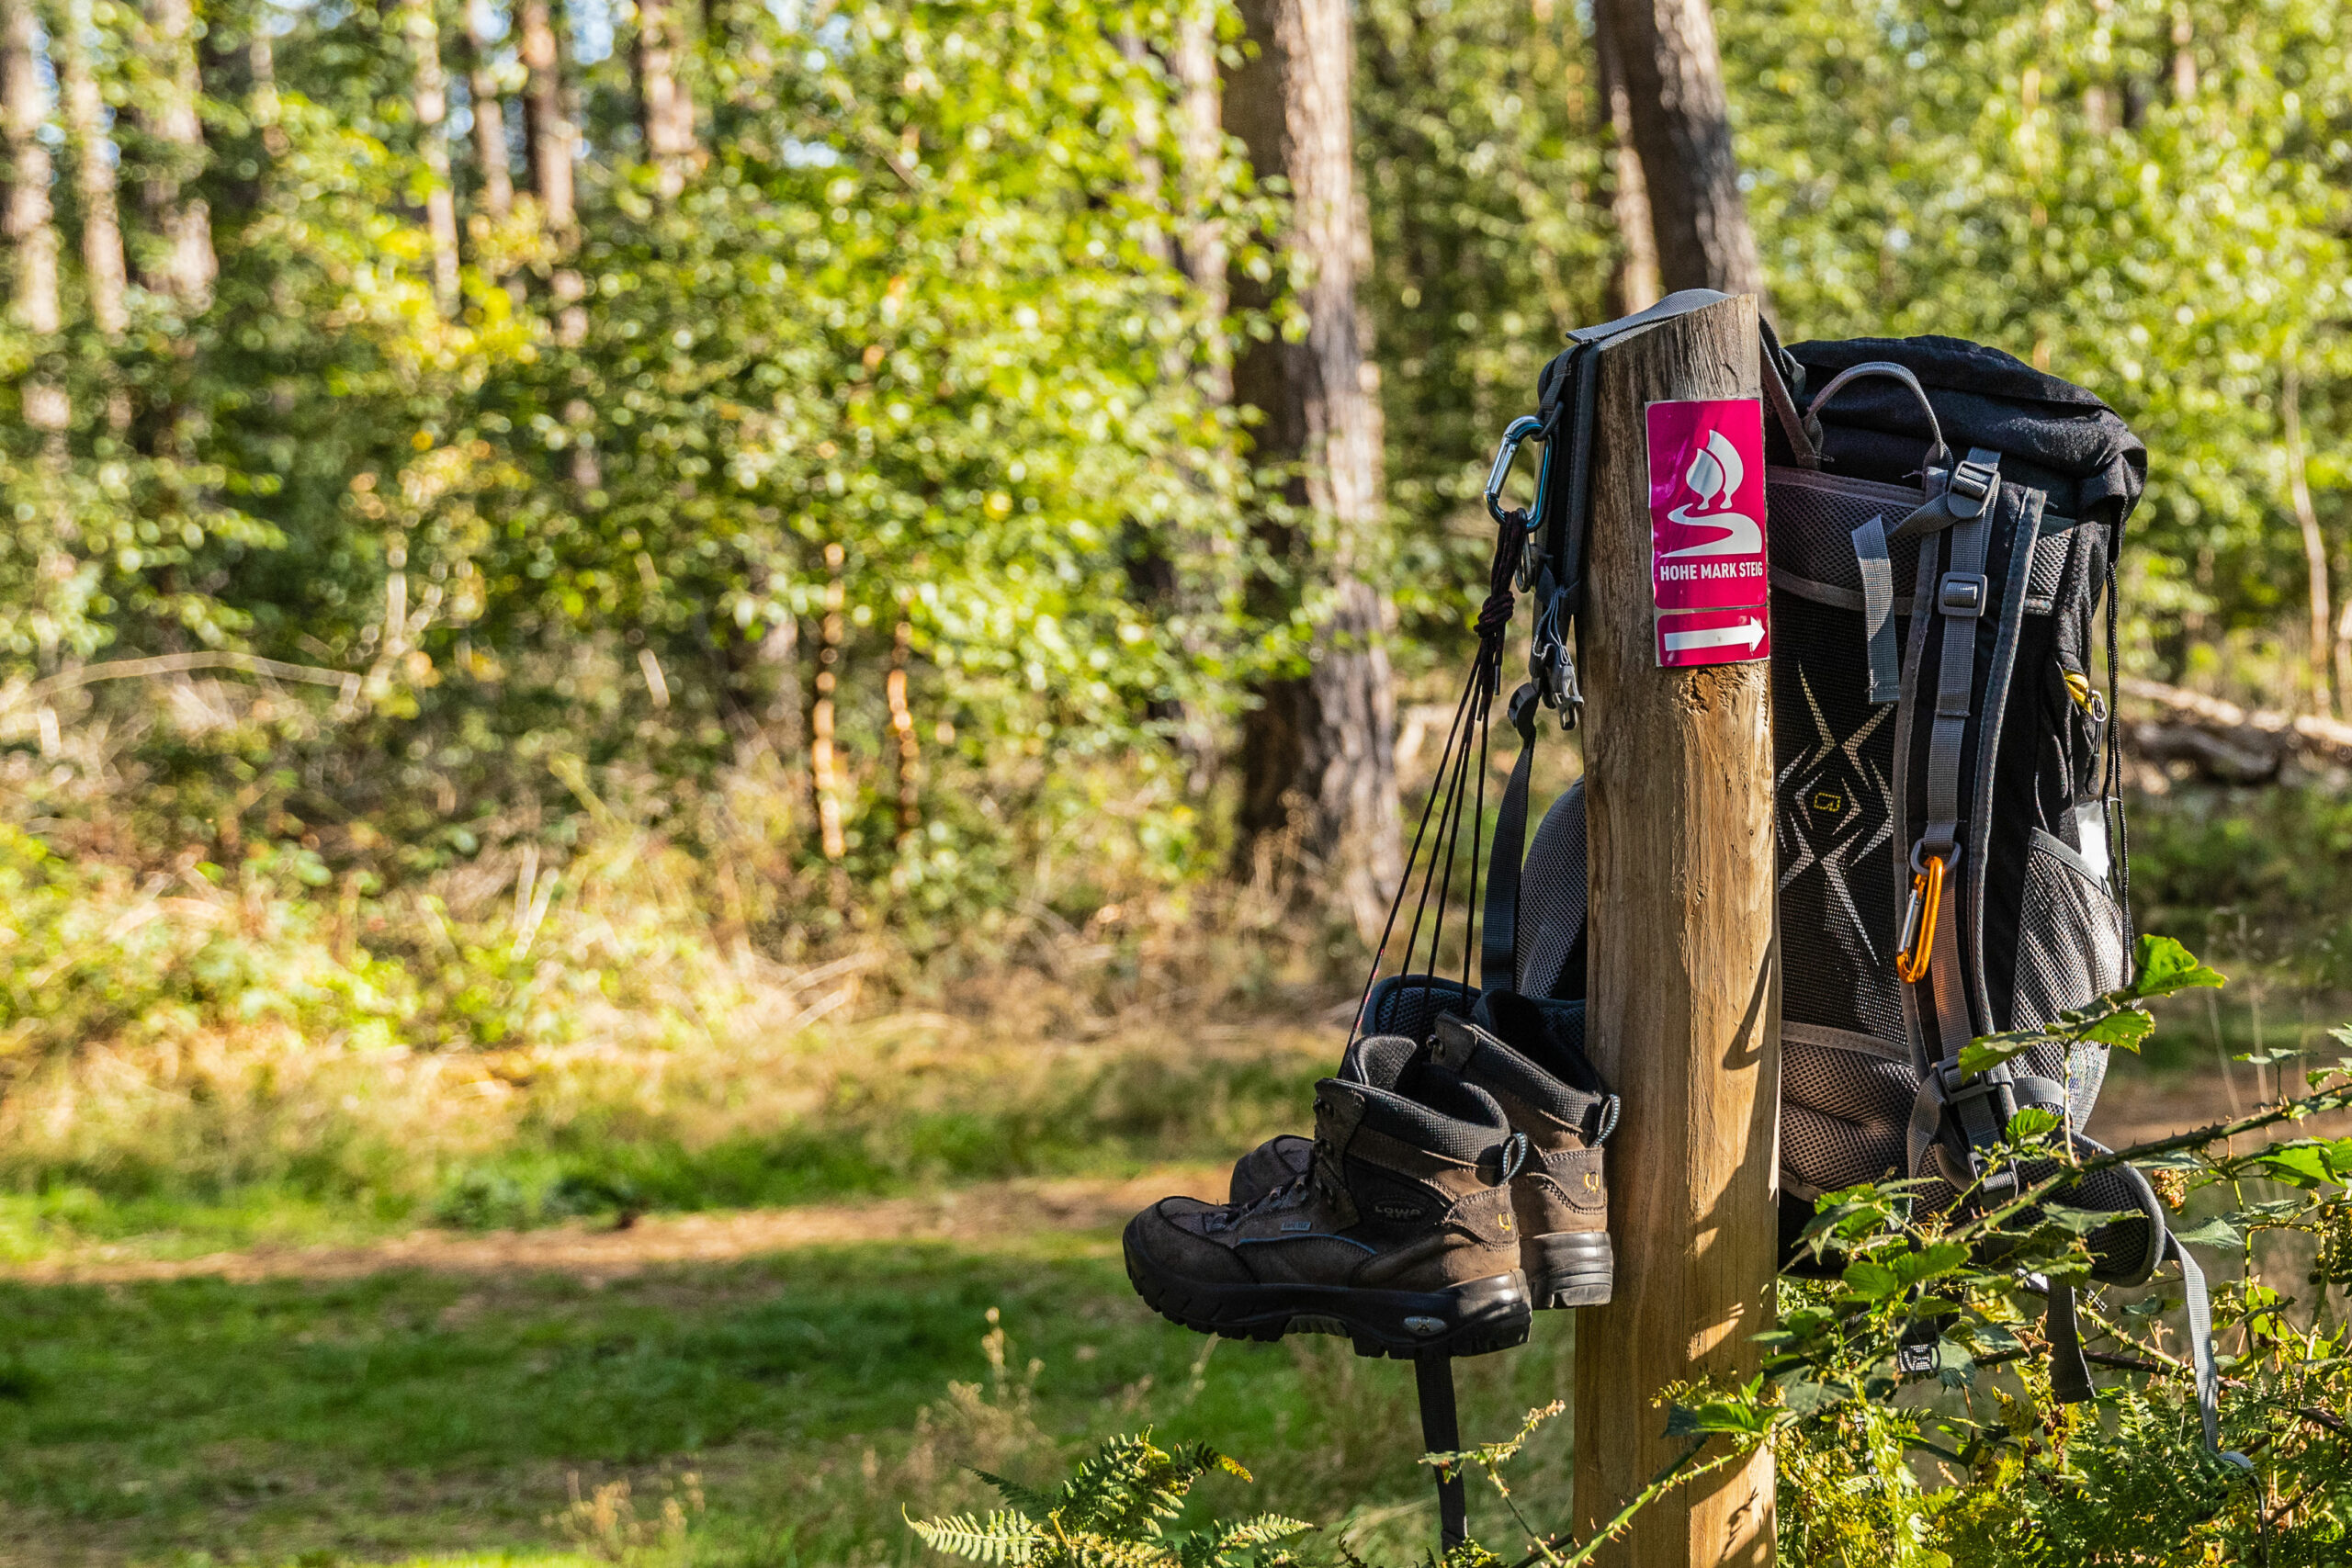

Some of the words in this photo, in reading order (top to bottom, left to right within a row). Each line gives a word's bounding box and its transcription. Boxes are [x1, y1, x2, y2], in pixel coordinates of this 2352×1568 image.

[1660, 564, 1697, 581] HOHE
[1701, 563, 1737, 580] MARK
[1738, 561, 1763, 578] STEIG
[1374, 1206, 1421, 1215] LOWA
